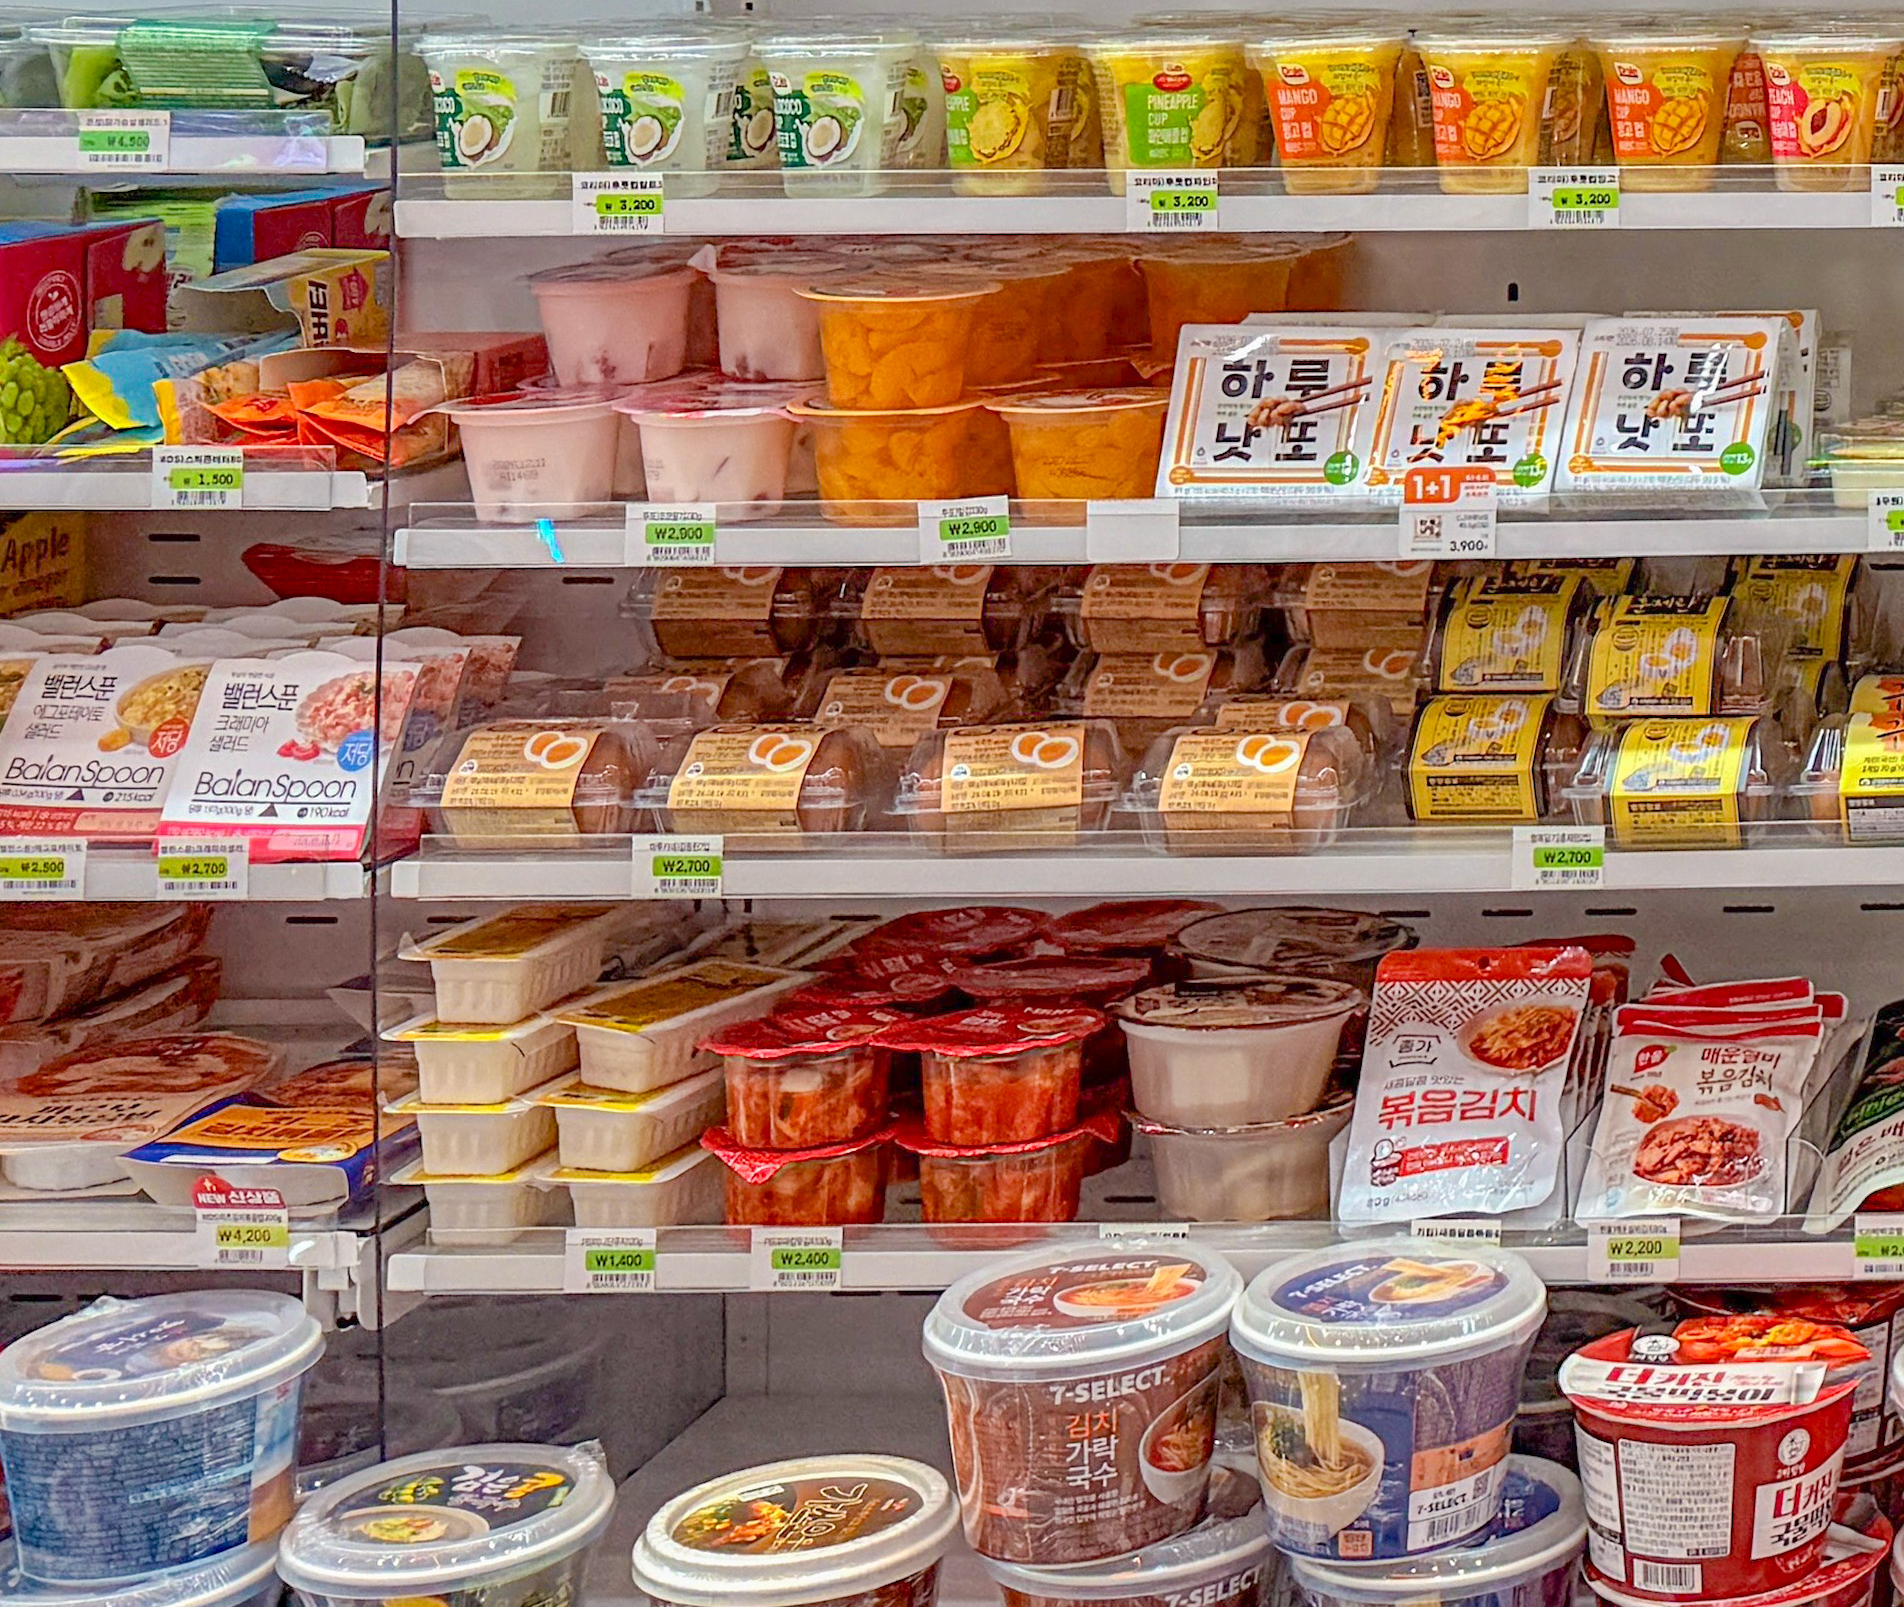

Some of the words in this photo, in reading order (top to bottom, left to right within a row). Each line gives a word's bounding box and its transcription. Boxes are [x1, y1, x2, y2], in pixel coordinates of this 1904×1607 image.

[1220, 356, 1331, 401] 하루
[1411, 477, 1451, 500] 1+1
[2, 528, 71, 572] Apple
[1378, 1085, 1538, 1131] 볶음김치
[197, 1192, 227, 1205] NEW
[218, 1229, 272, 1245] ₩4,200
[1610, 1240, 1663, 1256] ₩2,200
[1049, 1365, 1166, 1407] 7-SELECT
[1064, 1406, 1120, 1438] 김치
[1064, 1438, 1120, 1464] 가락
[1064, 1463, 1120, 1491] 국수
